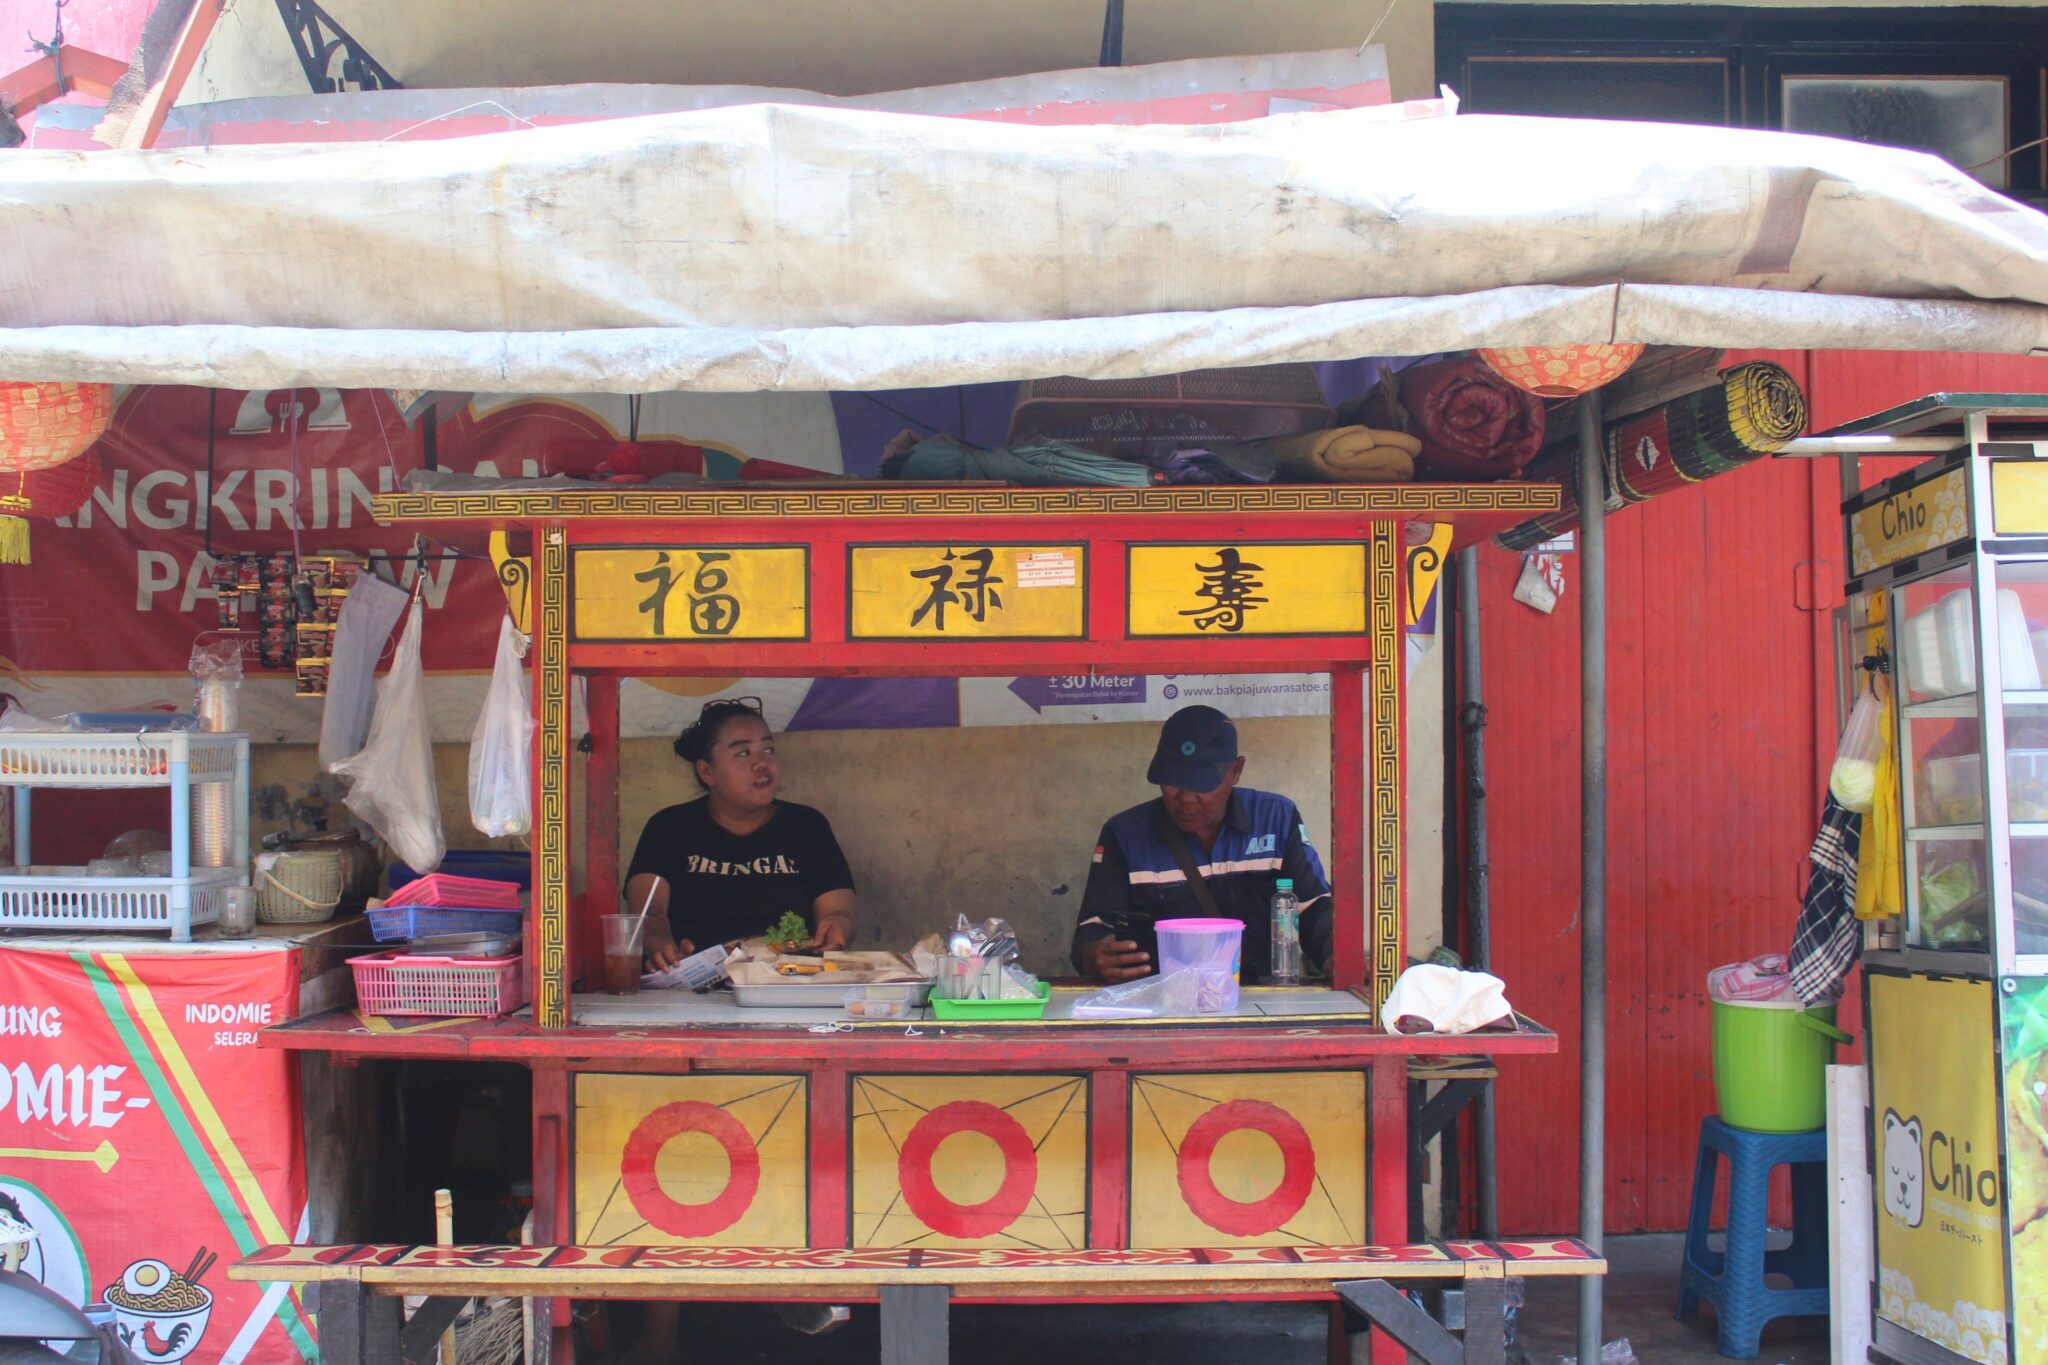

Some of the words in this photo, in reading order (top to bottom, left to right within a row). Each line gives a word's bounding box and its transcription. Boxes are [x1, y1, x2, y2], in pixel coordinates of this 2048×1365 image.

[57, 458, 540, 532] NGKRIN
[1881, 490, 1926, 540] Chio
[634, 550, 741, 636] 福
[1062, 675, 1086, 689] 30
[1090, 675, 1136, 689] Meter
[185, 1003, 272, 1025] INDOMIE
[1928, 1129, 1997, 1207] Chio
